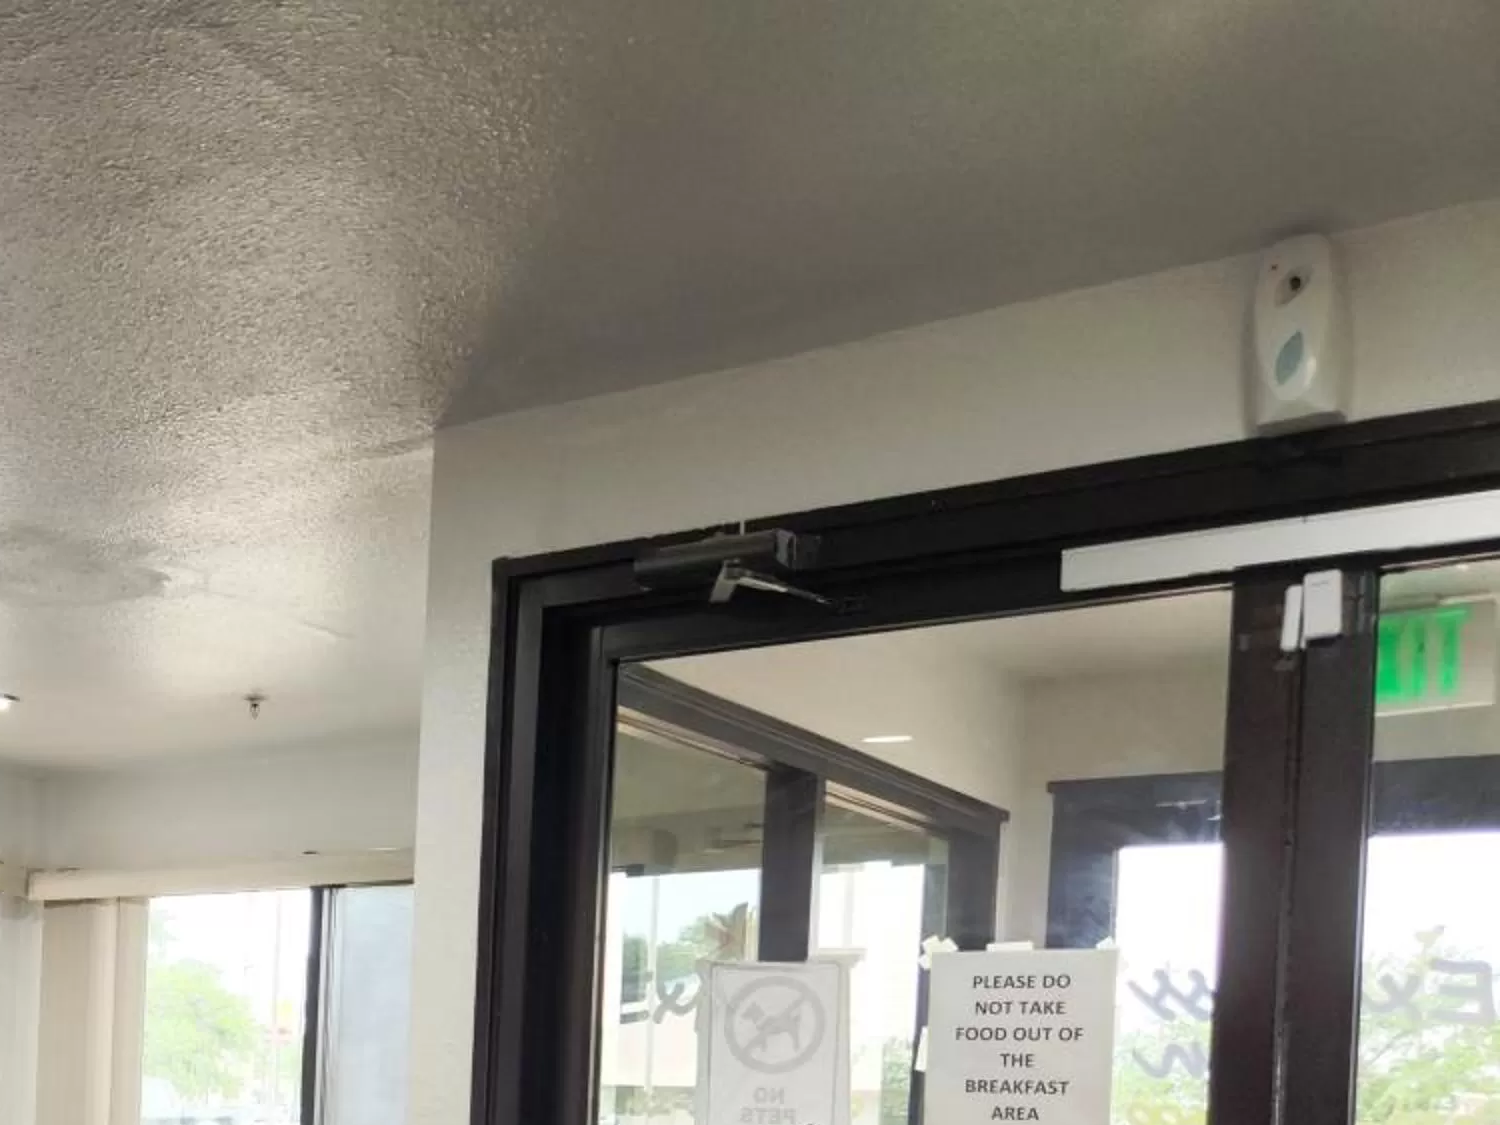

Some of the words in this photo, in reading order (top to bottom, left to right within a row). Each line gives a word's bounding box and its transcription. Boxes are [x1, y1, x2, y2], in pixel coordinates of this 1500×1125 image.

[972, 974, 1037, 990] PLEASE
[1042, 974, 1072, 989] DO
[975, 1000, 1014, 1016] NOT
[1019, 1001, 1067, 1015] TAKE
[955, 1027, 1007, 1042] FOOD
[1013, 1027, 1053, 1041] OUT
[1058, 1027, 1085, 1042] OF
[999, 1053, 1036, 1068] THE
[965, 1079, 1070, 1096] BREAKFAST
[991, 1106, 1040, 1121] AREA
